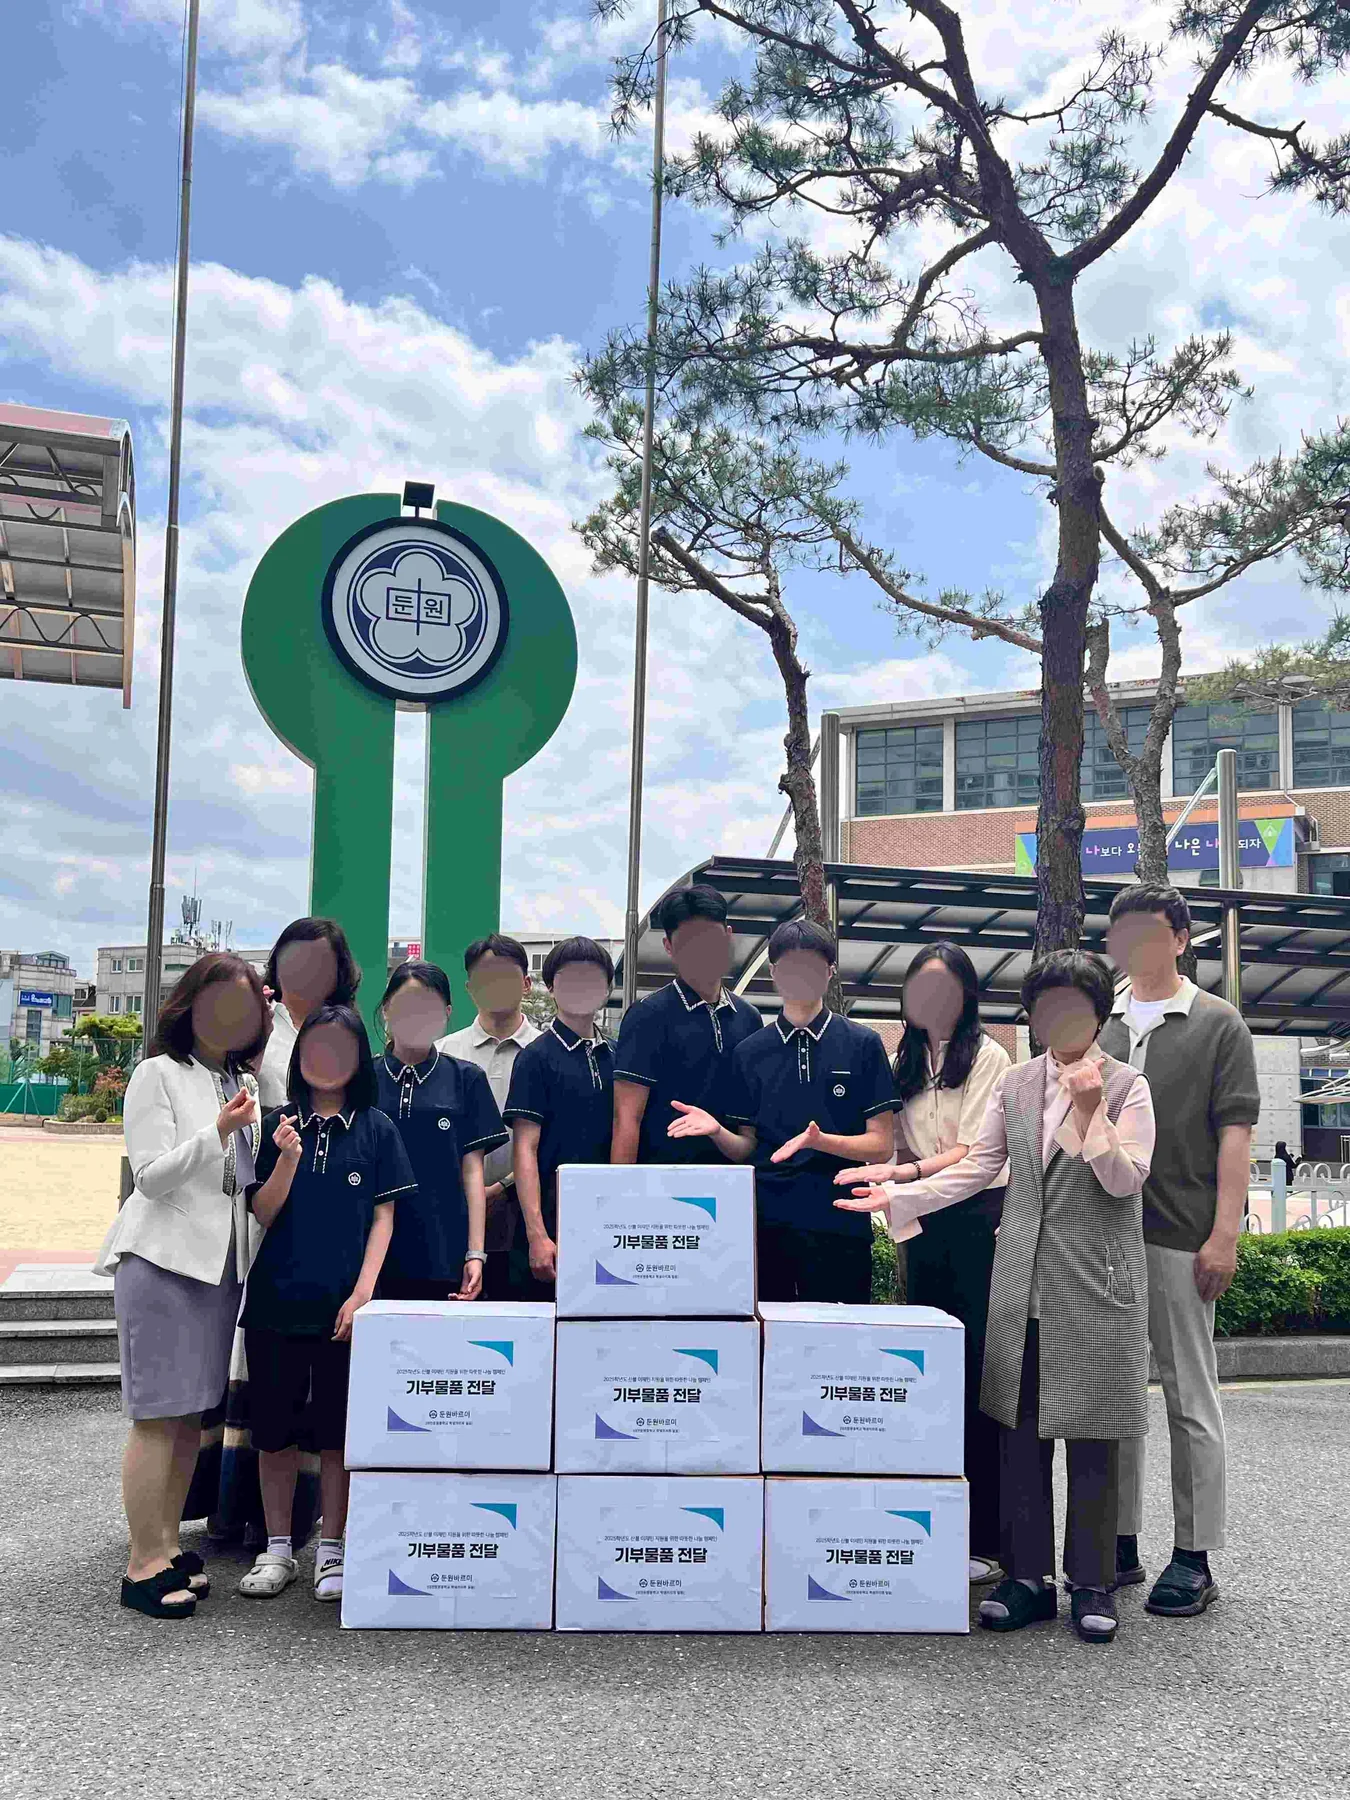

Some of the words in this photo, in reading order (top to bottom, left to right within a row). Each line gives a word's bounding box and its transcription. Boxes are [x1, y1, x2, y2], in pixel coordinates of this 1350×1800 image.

[392, 594, 443, 620] 둔원
[1085, 844, 1123, 857] 나보다
[1174, 838, 1200, 856] 나은
[1237, 838, 1262, 850] 되자
[613, 1235, 668, 1249] 기부물품
[672, 1235, 700, 1249] 전달
[406, 1380, 463, 1395] 기부물품
[467, 1380, 496, 1395] 전달
[820, 1386, 875, 1401] 기부물품
[880, 1388, 907, 1402] 전달
[613, 1388, 669, 1403] 기부물품
[673, 1388, 701, 1403] 전달
[408, 1543, 465, 1558] 기부물품
[470, 1544, 499, 1558] 전달
[615, 1547, 674, 1563] 기부물품
[678, 1547, 707, 1563] 전달
[826, 1549, 882, 1564] 기부물품
[886, 1550, 914, 1564] 전달
